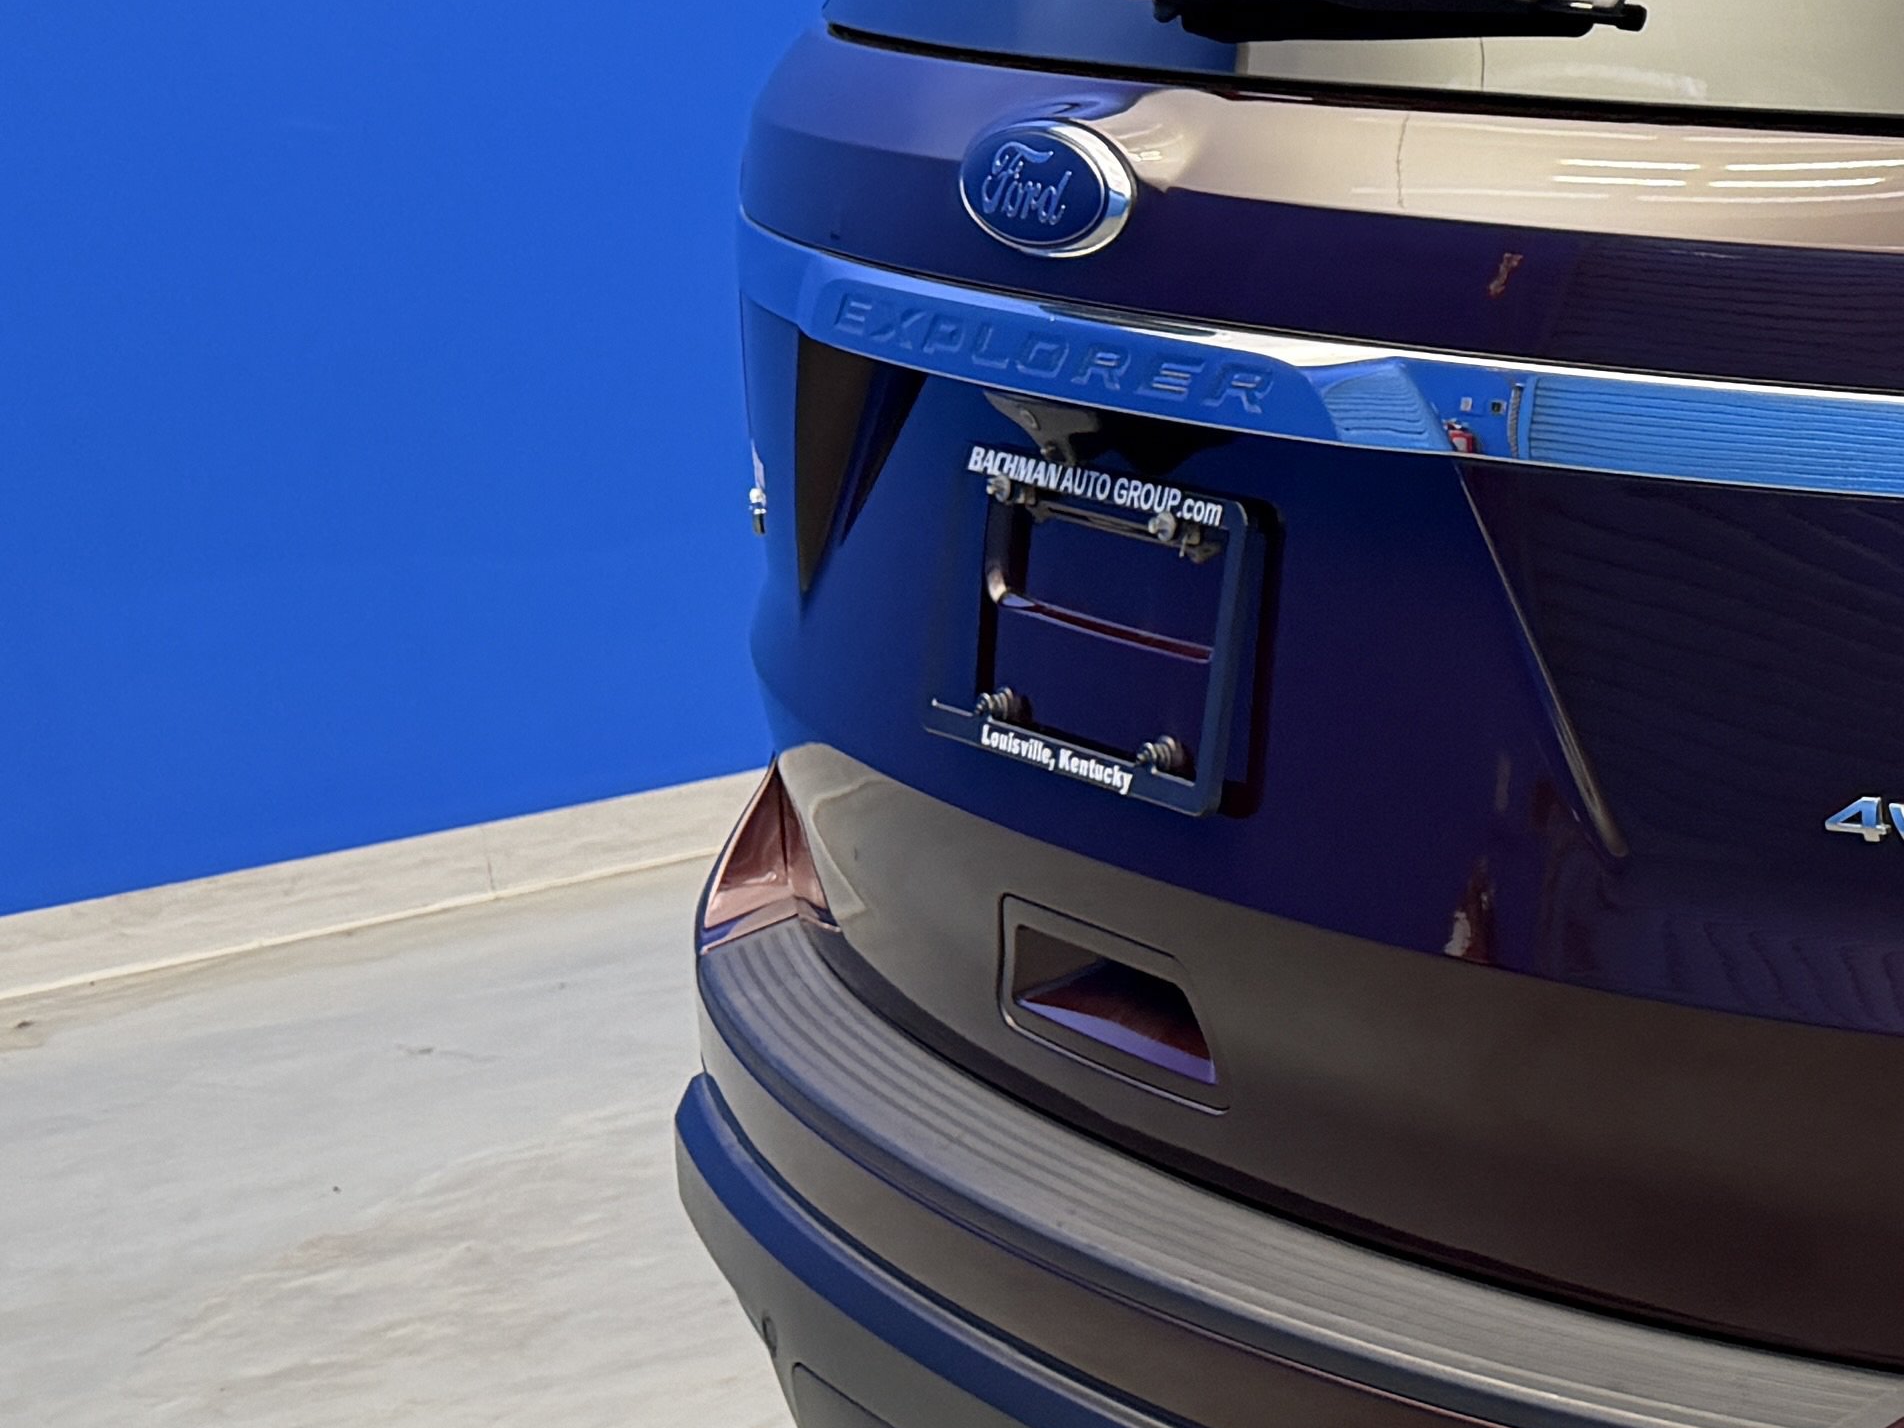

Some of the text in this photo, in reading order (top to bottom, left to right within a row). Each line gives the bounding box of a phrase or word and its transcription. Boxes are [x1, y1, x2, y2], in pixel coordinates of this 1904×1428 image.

[981, 141, 1072, 226] Ford
[833, 292, 1275, 414] EXPLORER
[967, 445, 1224, 527] BACHMAN AUTO GROUP.com
[980, 723, 1133, 796] Louisville, Kentucky
